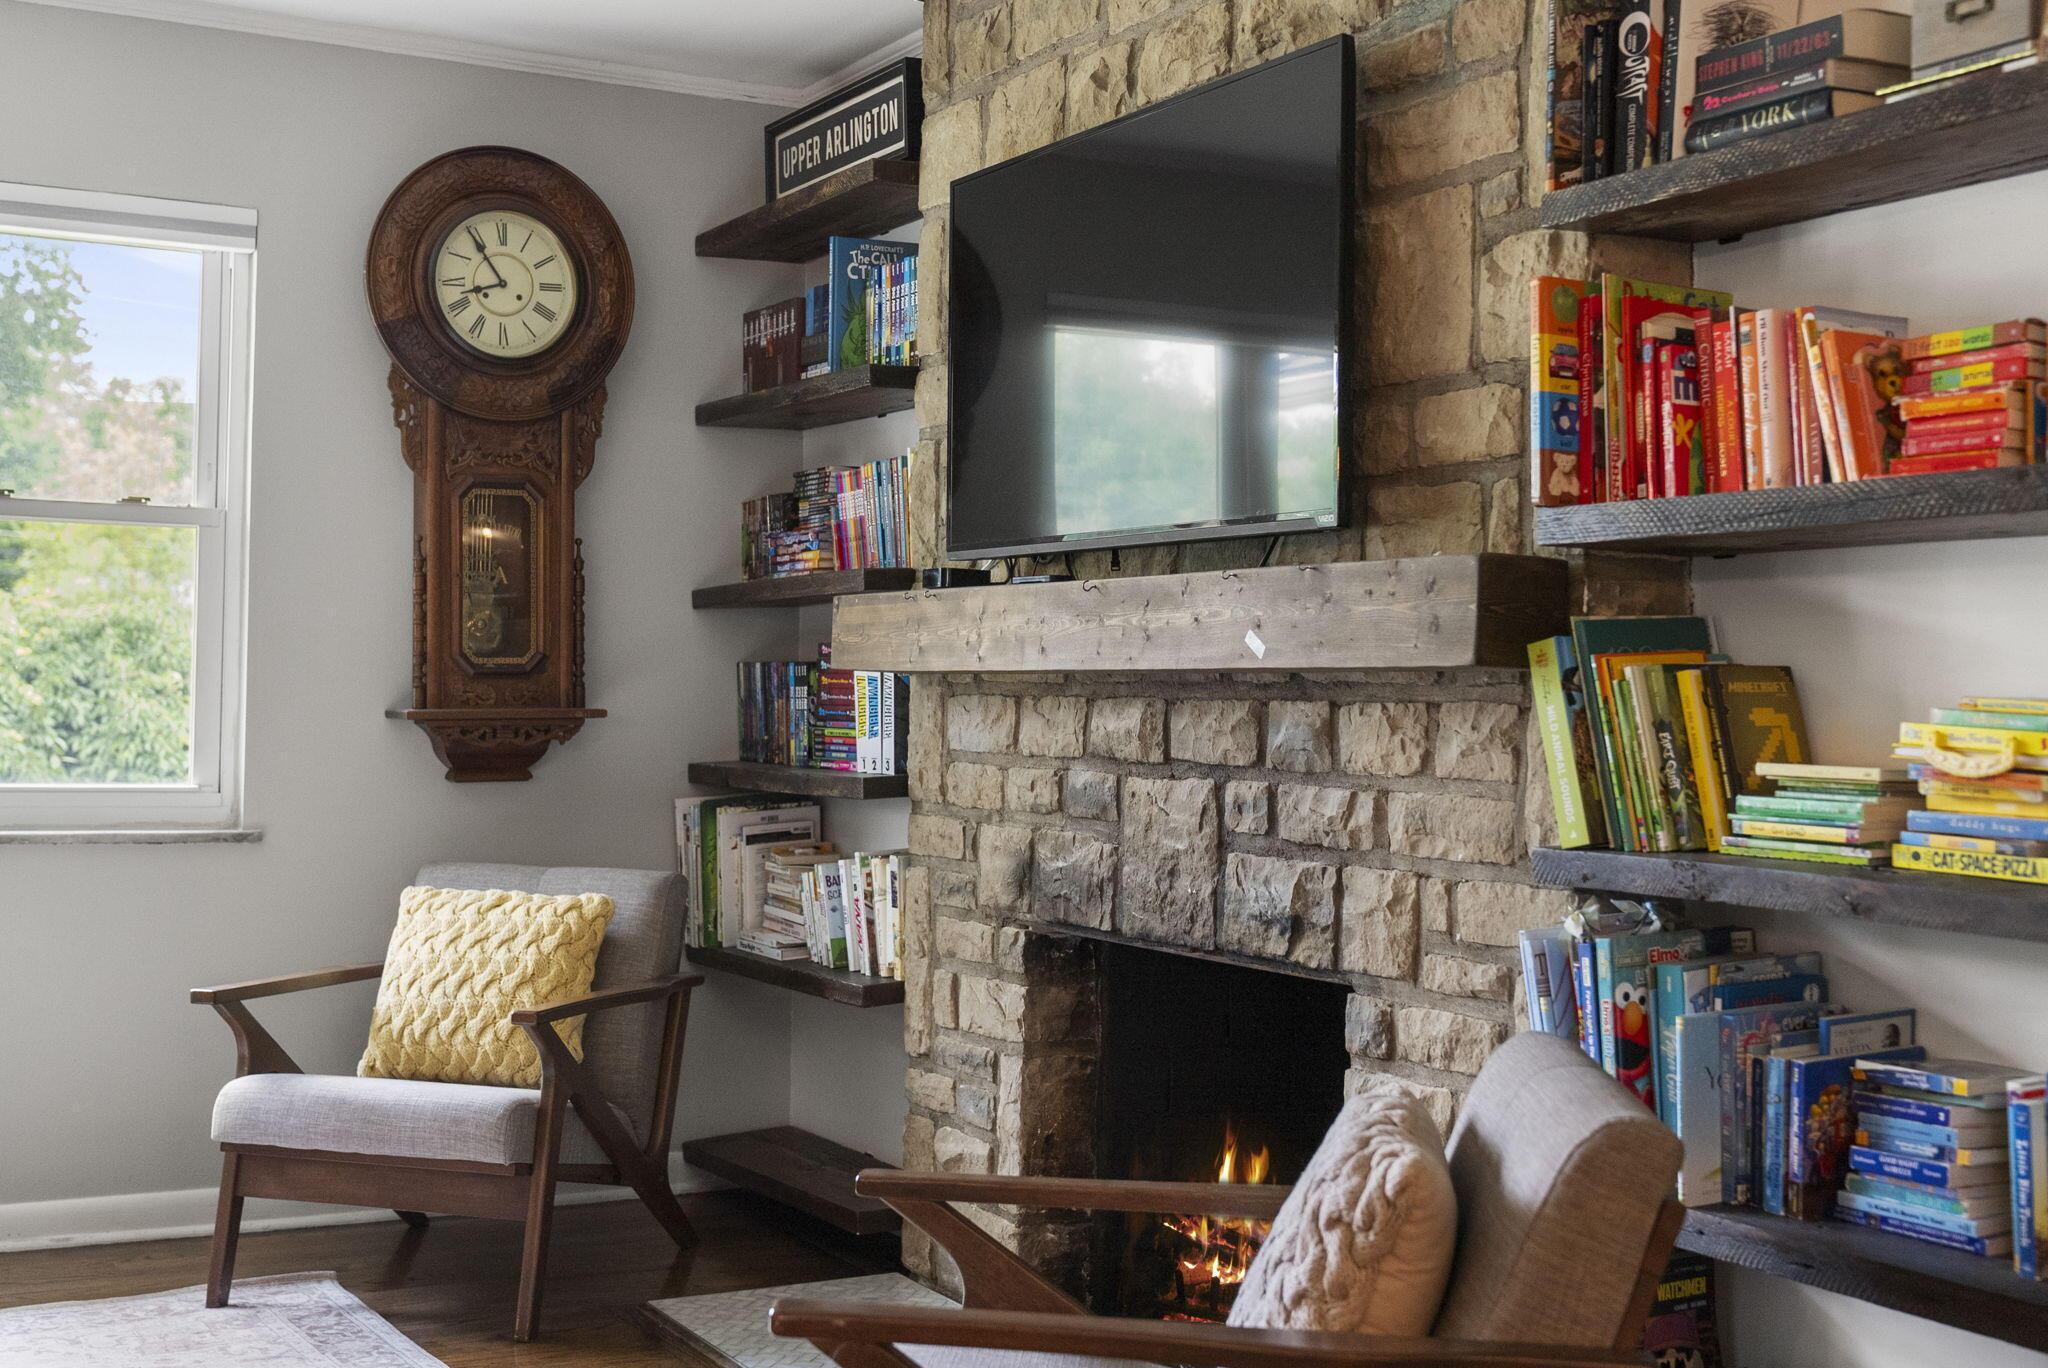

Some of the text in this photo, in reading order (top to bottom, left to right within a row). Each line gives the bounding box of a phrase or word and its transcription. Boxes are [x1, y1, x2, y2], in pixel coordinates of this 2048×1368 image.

[1627, 104, 1635, 136] COMPLETE
[783, 98, 898, 179] UPPER ARLINGTON
[850, 250, 870, 264] The
[1714, 342, 1724, 372] MAAS
[1723, 331, 1733, 368] SARAH
[1698, 343, 1710, 408] CATHOLIC
[1727, 411, 1735, 446] COURT
[1718, 442, 1727, 477] ROSES
[868, 675, 879, 740] INVINCIBLE
[883, 672, 894, 739] INVINCIBLE
[1545, 705, 1560, 731] WILD
[862, 759, 866, 770] 1
[871, 760, 877, 770] 2
[885, 760, 890, 771] 3
[1550, 733, 1568, 776] ANIMAL
[1558, 777, 1577, 823] SOUNDS
[1932, 851, 2039, 878] CAT SPACE PIZZA
[2014, 1138, 2033, 1248] Little Blue Truck
[1657, 1276, 1706, 1301] WATCHMEN
